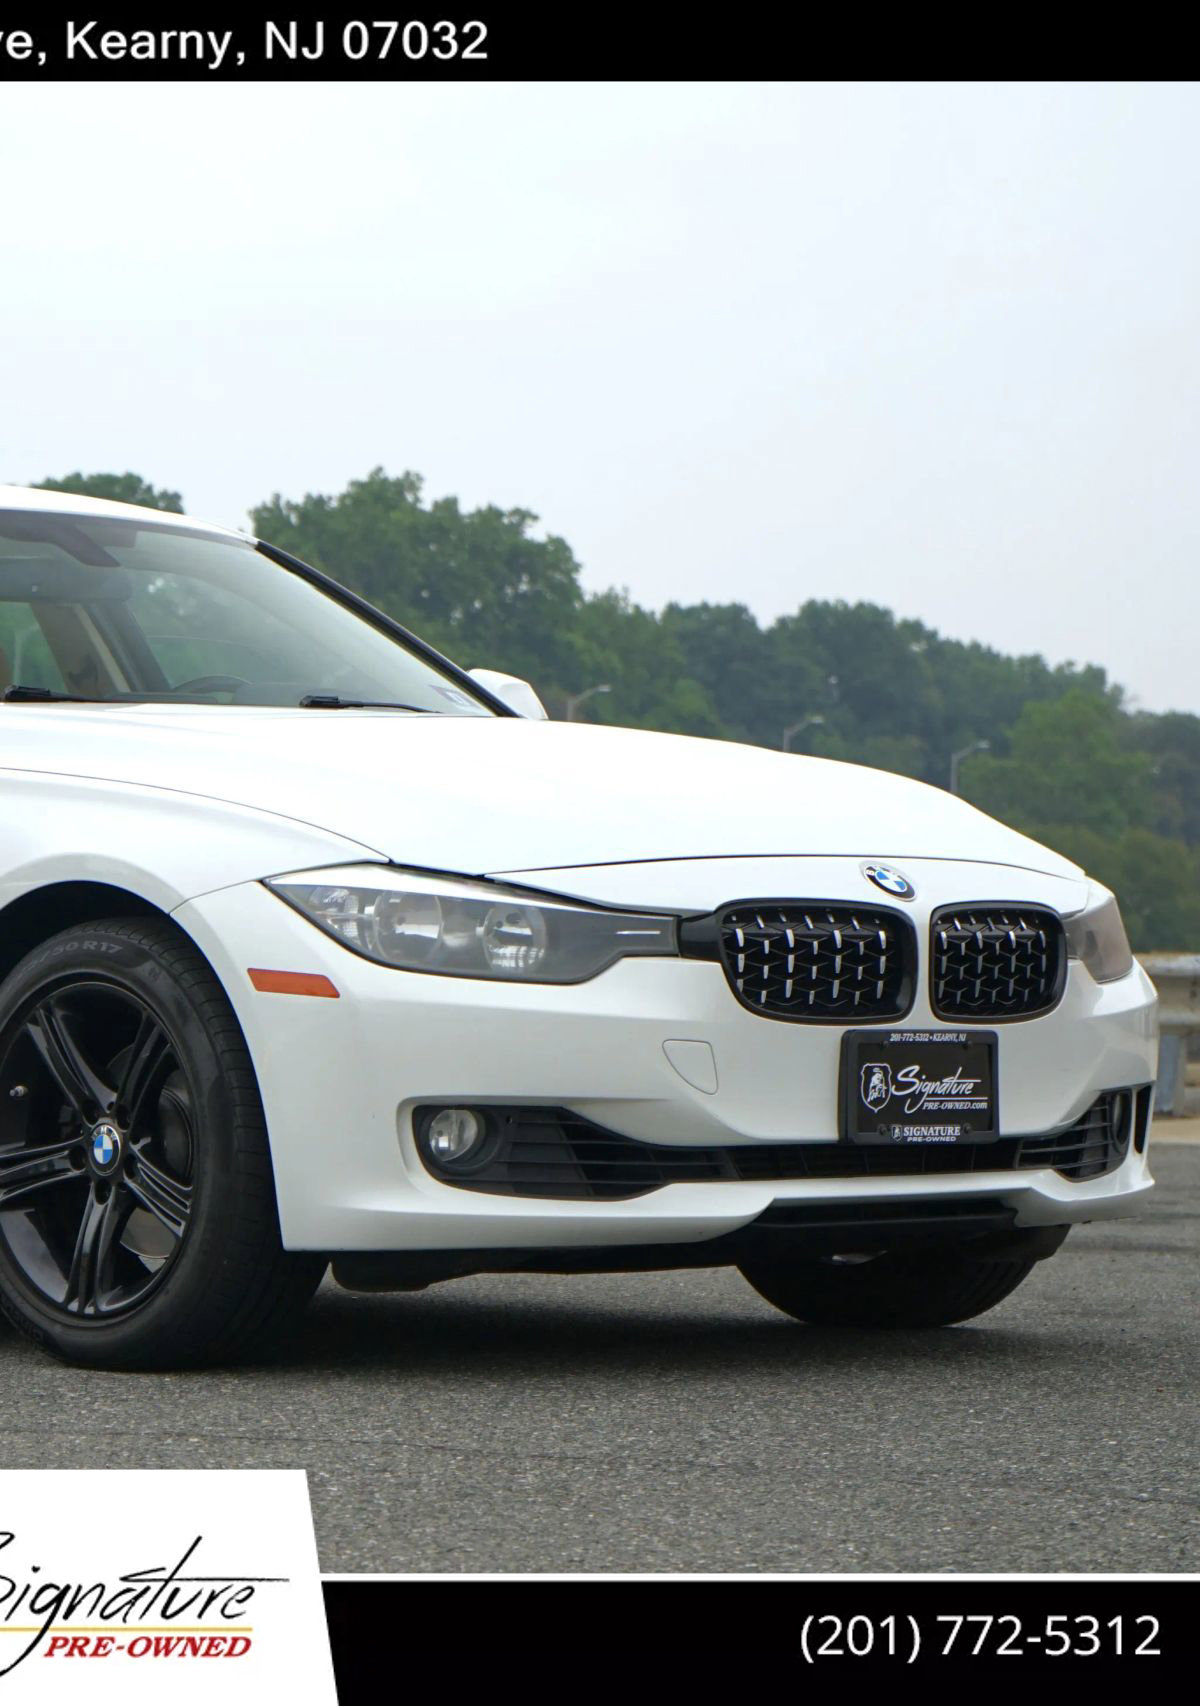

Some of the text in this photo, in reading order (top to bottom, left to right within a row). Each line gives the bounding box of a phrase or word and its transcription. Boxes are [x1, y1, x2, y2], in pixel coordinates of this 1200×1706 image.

[892, 1065, 981, 1114] Signature
[922, 1101, 988, 1111] PRE-OWNED.com
[903, 1126, 961, 1136] SIGNATURE
